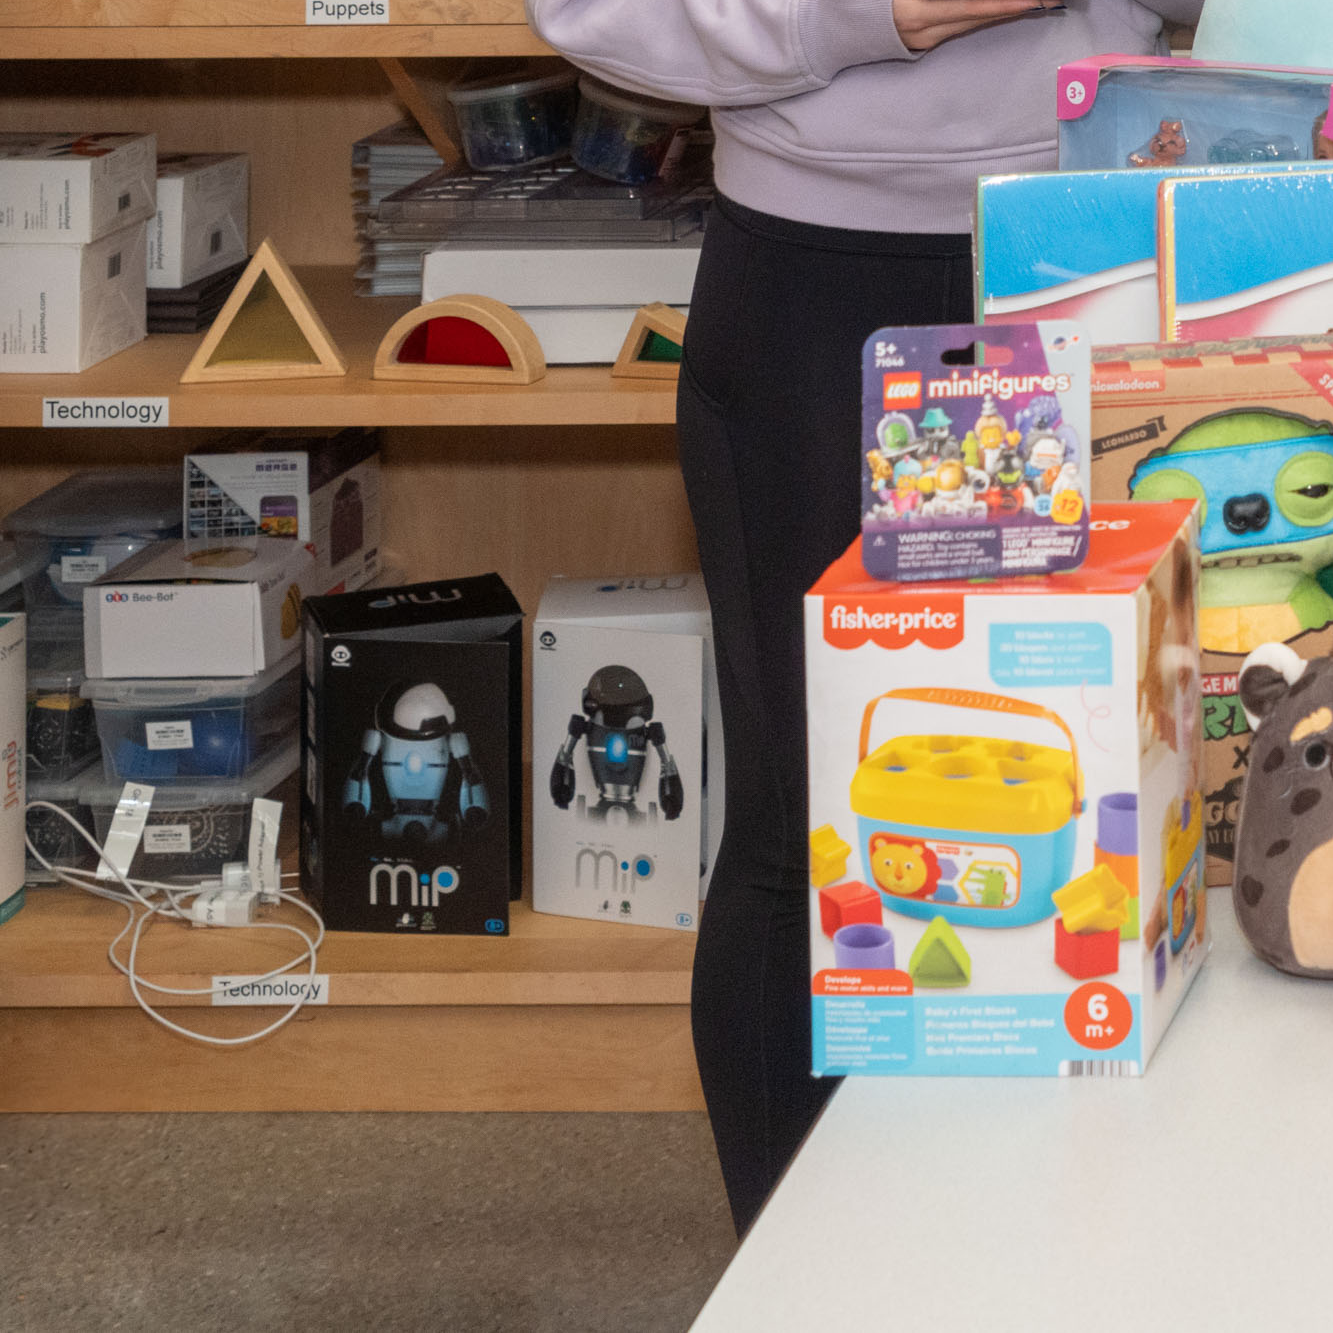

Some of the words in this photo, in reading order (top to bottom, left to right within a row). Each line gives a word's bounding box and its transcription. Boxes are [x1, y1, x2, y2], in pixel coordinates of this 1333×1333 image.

[312, 0, 385, 21] Puppets
[1068, 87, 1083, 99] 3+
[875, 342, 897, 356] 5+
[886, 381, 920, 399] LEGO
[928, 369, 1072, 400] minifigures
[46, 400, 164, 424] Technology
[1060, 498, 1078, 512] 12
[898, 530, 952, 543] WARNING:
[954, 528, 996, 540] CHOKING
[830, 604, 956, 635] fisher-price
[218, 978, 321, 1000] Technology
[1087, 994, 1110, 1022] 6
[1085, 1024, 1115, 1038] m+
